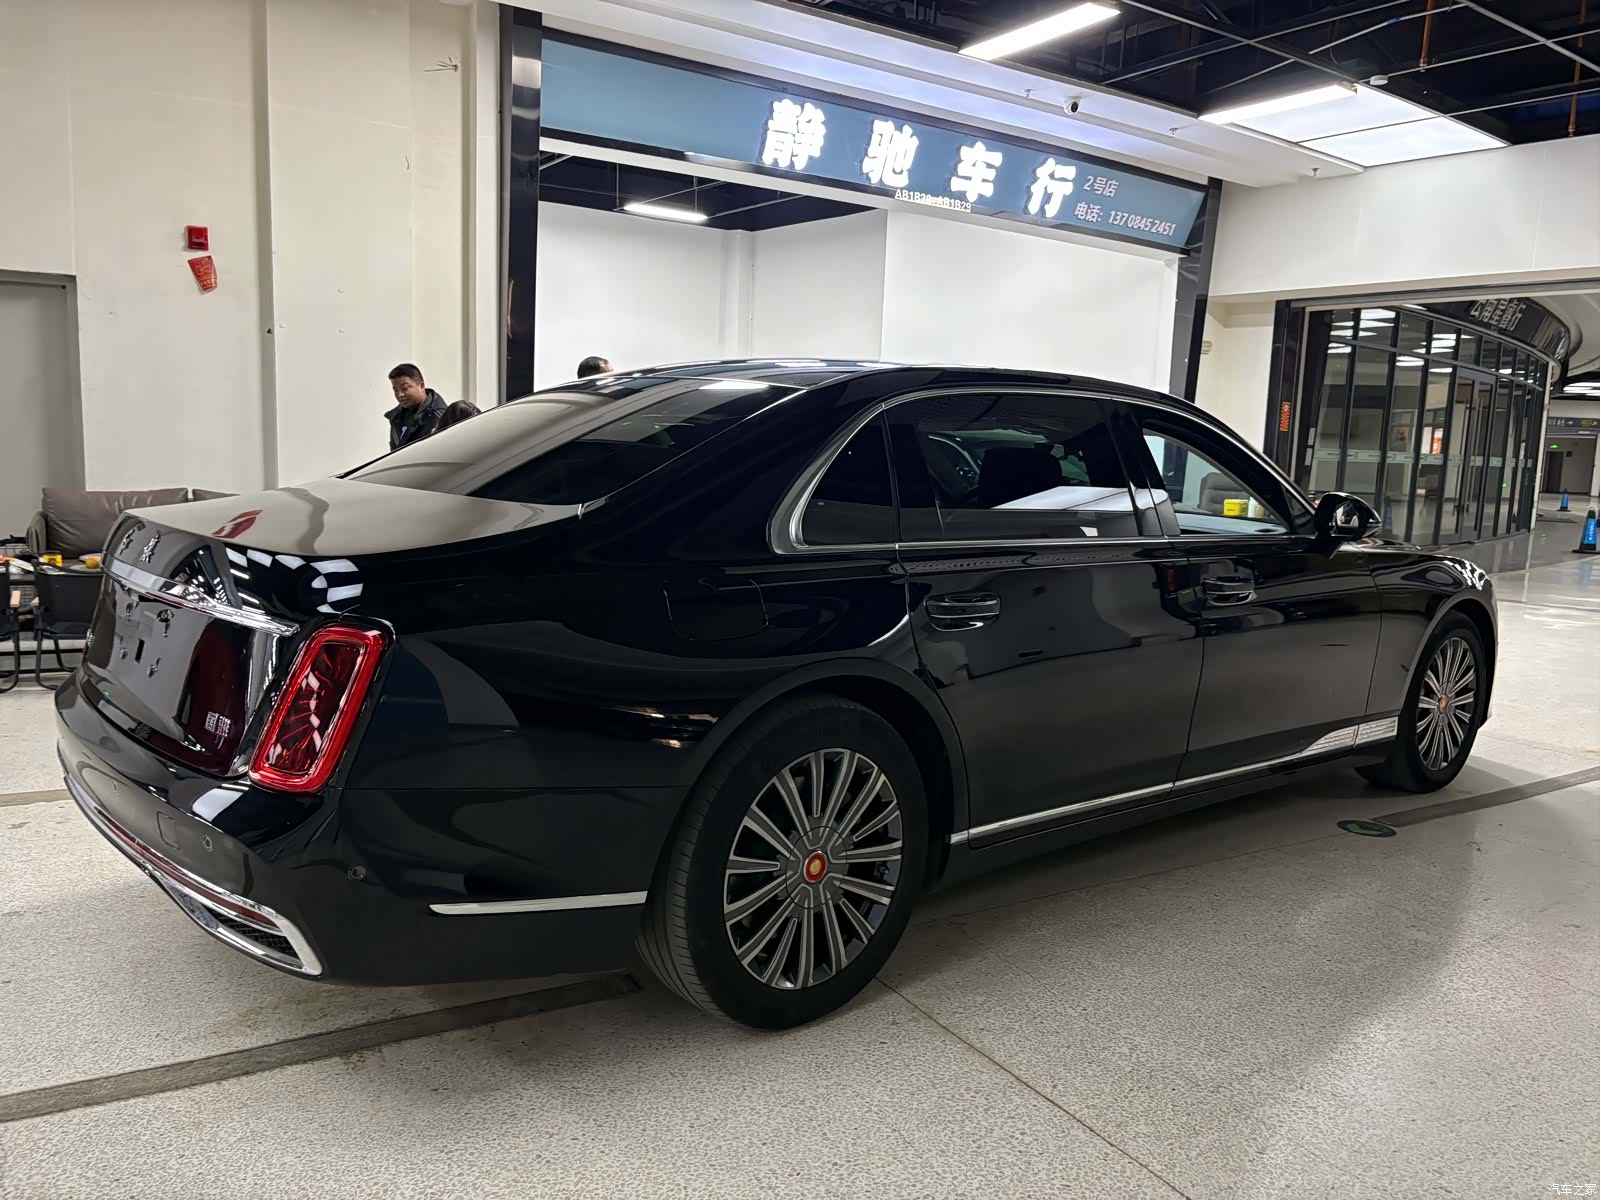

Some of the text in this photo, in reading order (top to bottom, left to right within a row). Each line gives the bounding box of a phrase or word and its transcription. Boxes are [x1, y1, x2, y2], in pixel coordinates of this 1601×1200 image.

[761, 98, 1077, 219] 静驰车行
[1083, 175, 1119, 198] 2号店
[1108, 210, 1176, 236] 13708452451
